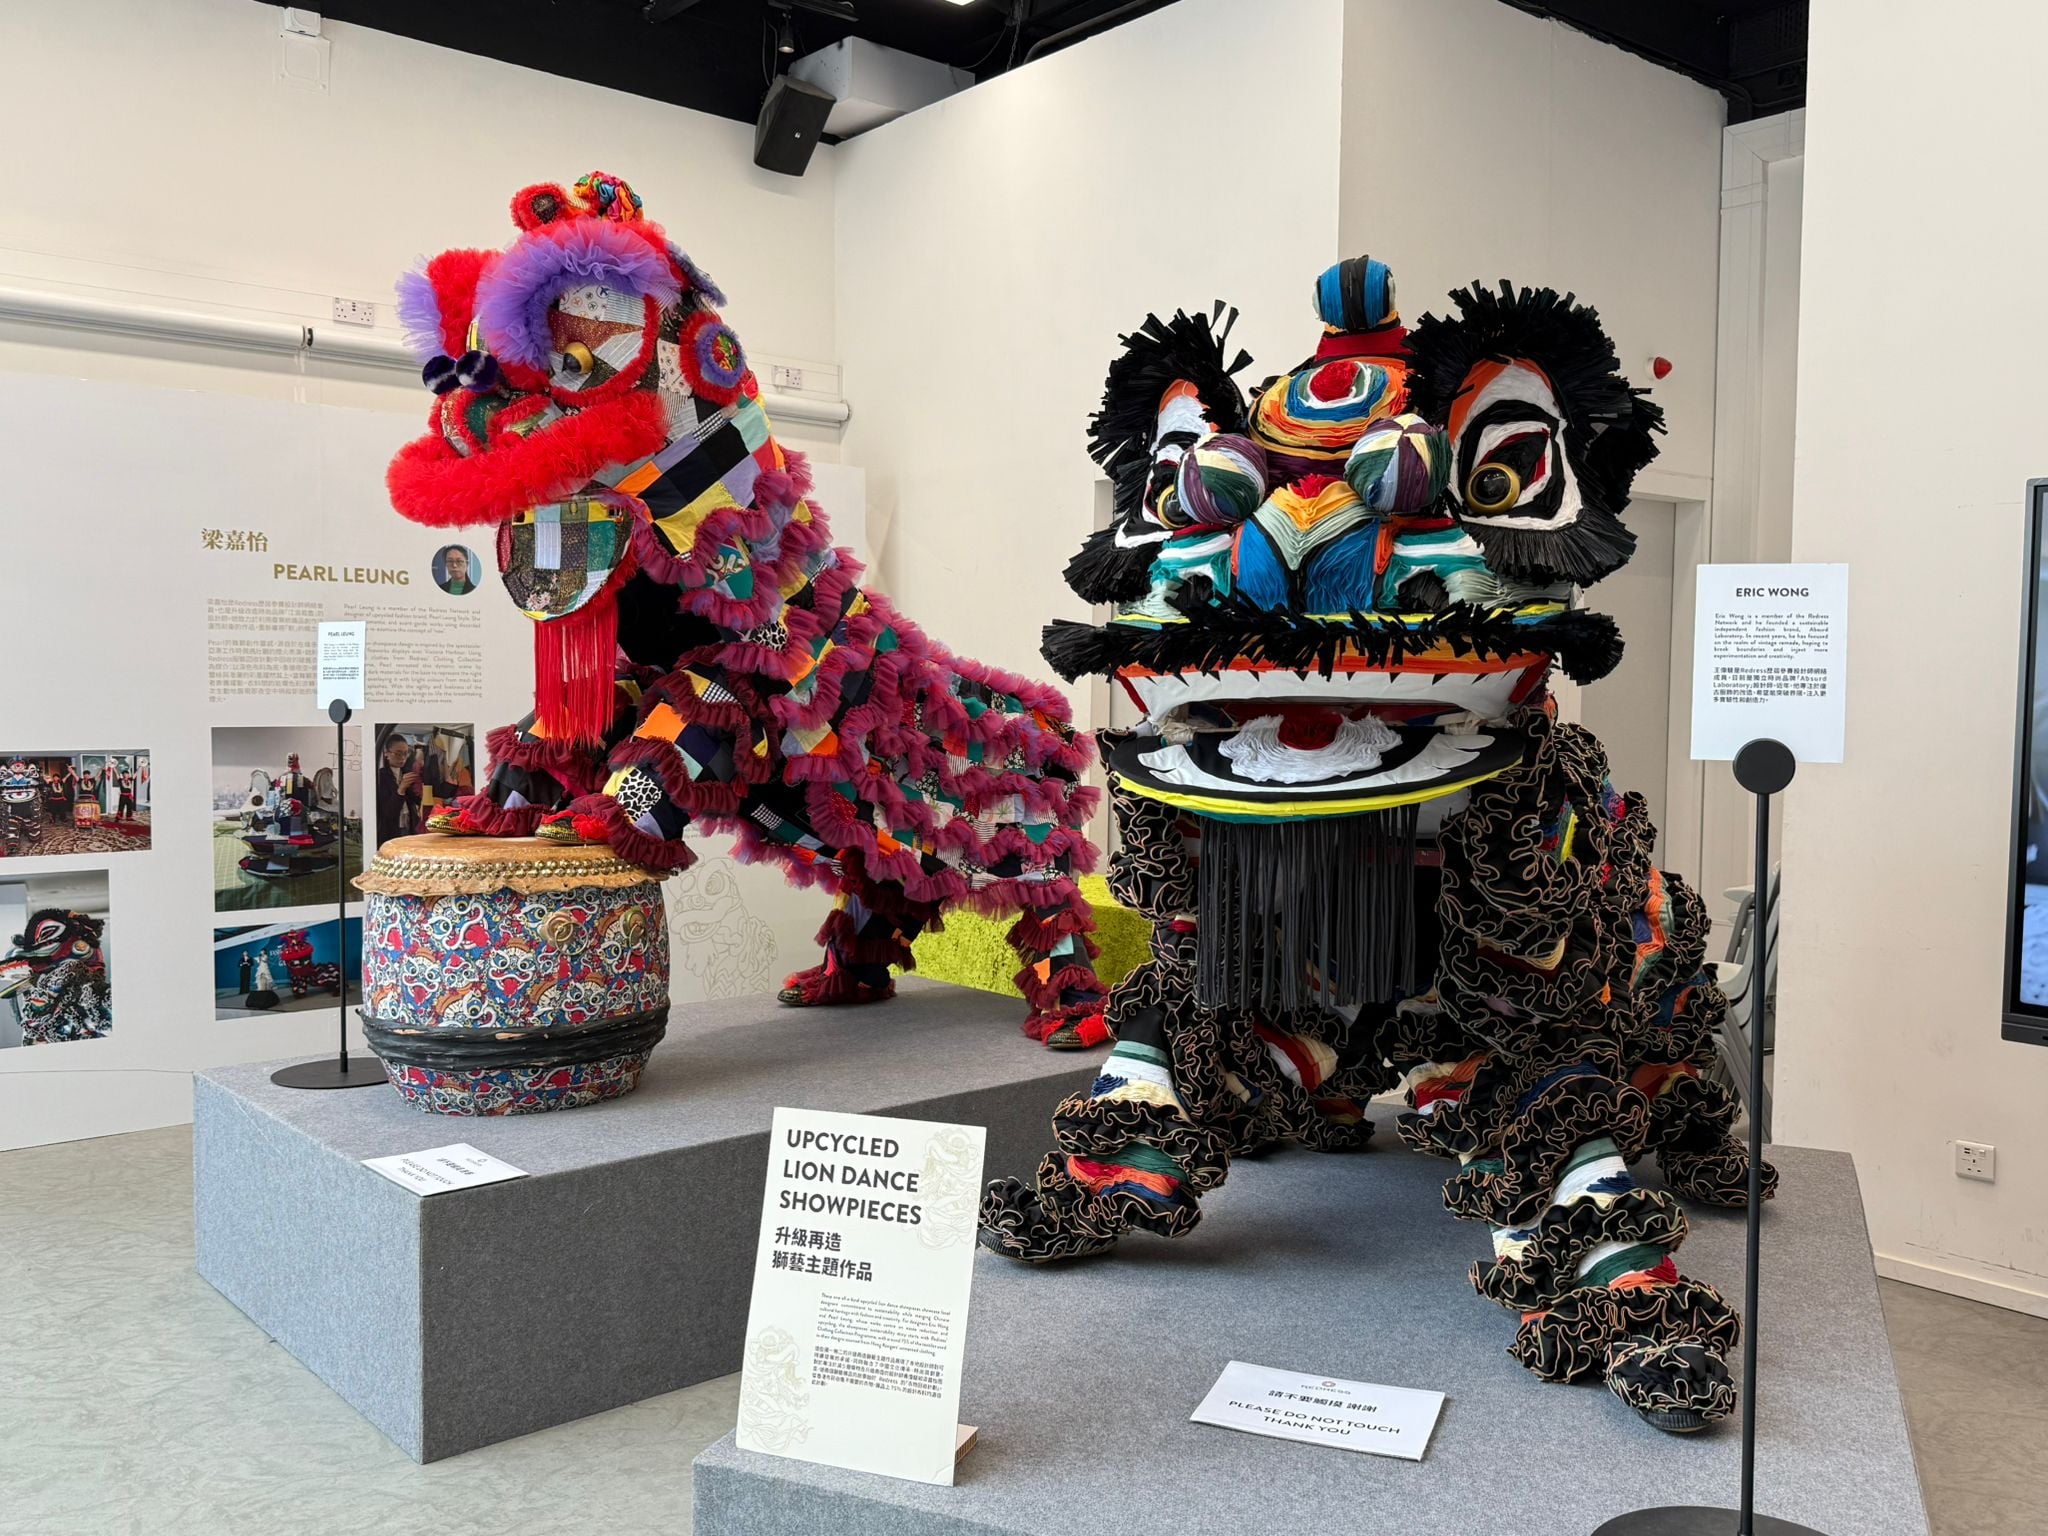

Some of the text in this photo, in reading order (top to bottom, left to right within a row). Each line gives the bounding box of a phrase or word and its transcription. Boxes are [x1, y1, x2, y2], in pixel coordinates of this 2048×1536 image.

[201, 528, 269, 553] 梁嘉怡
[274, 563, 410, 585] PEARL LEUNG
[1736, 587, 1809, 597] ERIC WONG
[787, 1129, 899, 1158] UPCYCLED
[783, 1159, 920, 1192] LION DANCE
[779, 1190, 922, 1225] SHOWPIECES
[775, 1226, 842, 1252] 升級再造
[771, 1250, 873, 1282] 獅藝主題作品
[1229, 1400, 1401, 1434] PLEASE DO NOT TOUCH
[1264, 1416, 1351, 1436] THANK YOU
